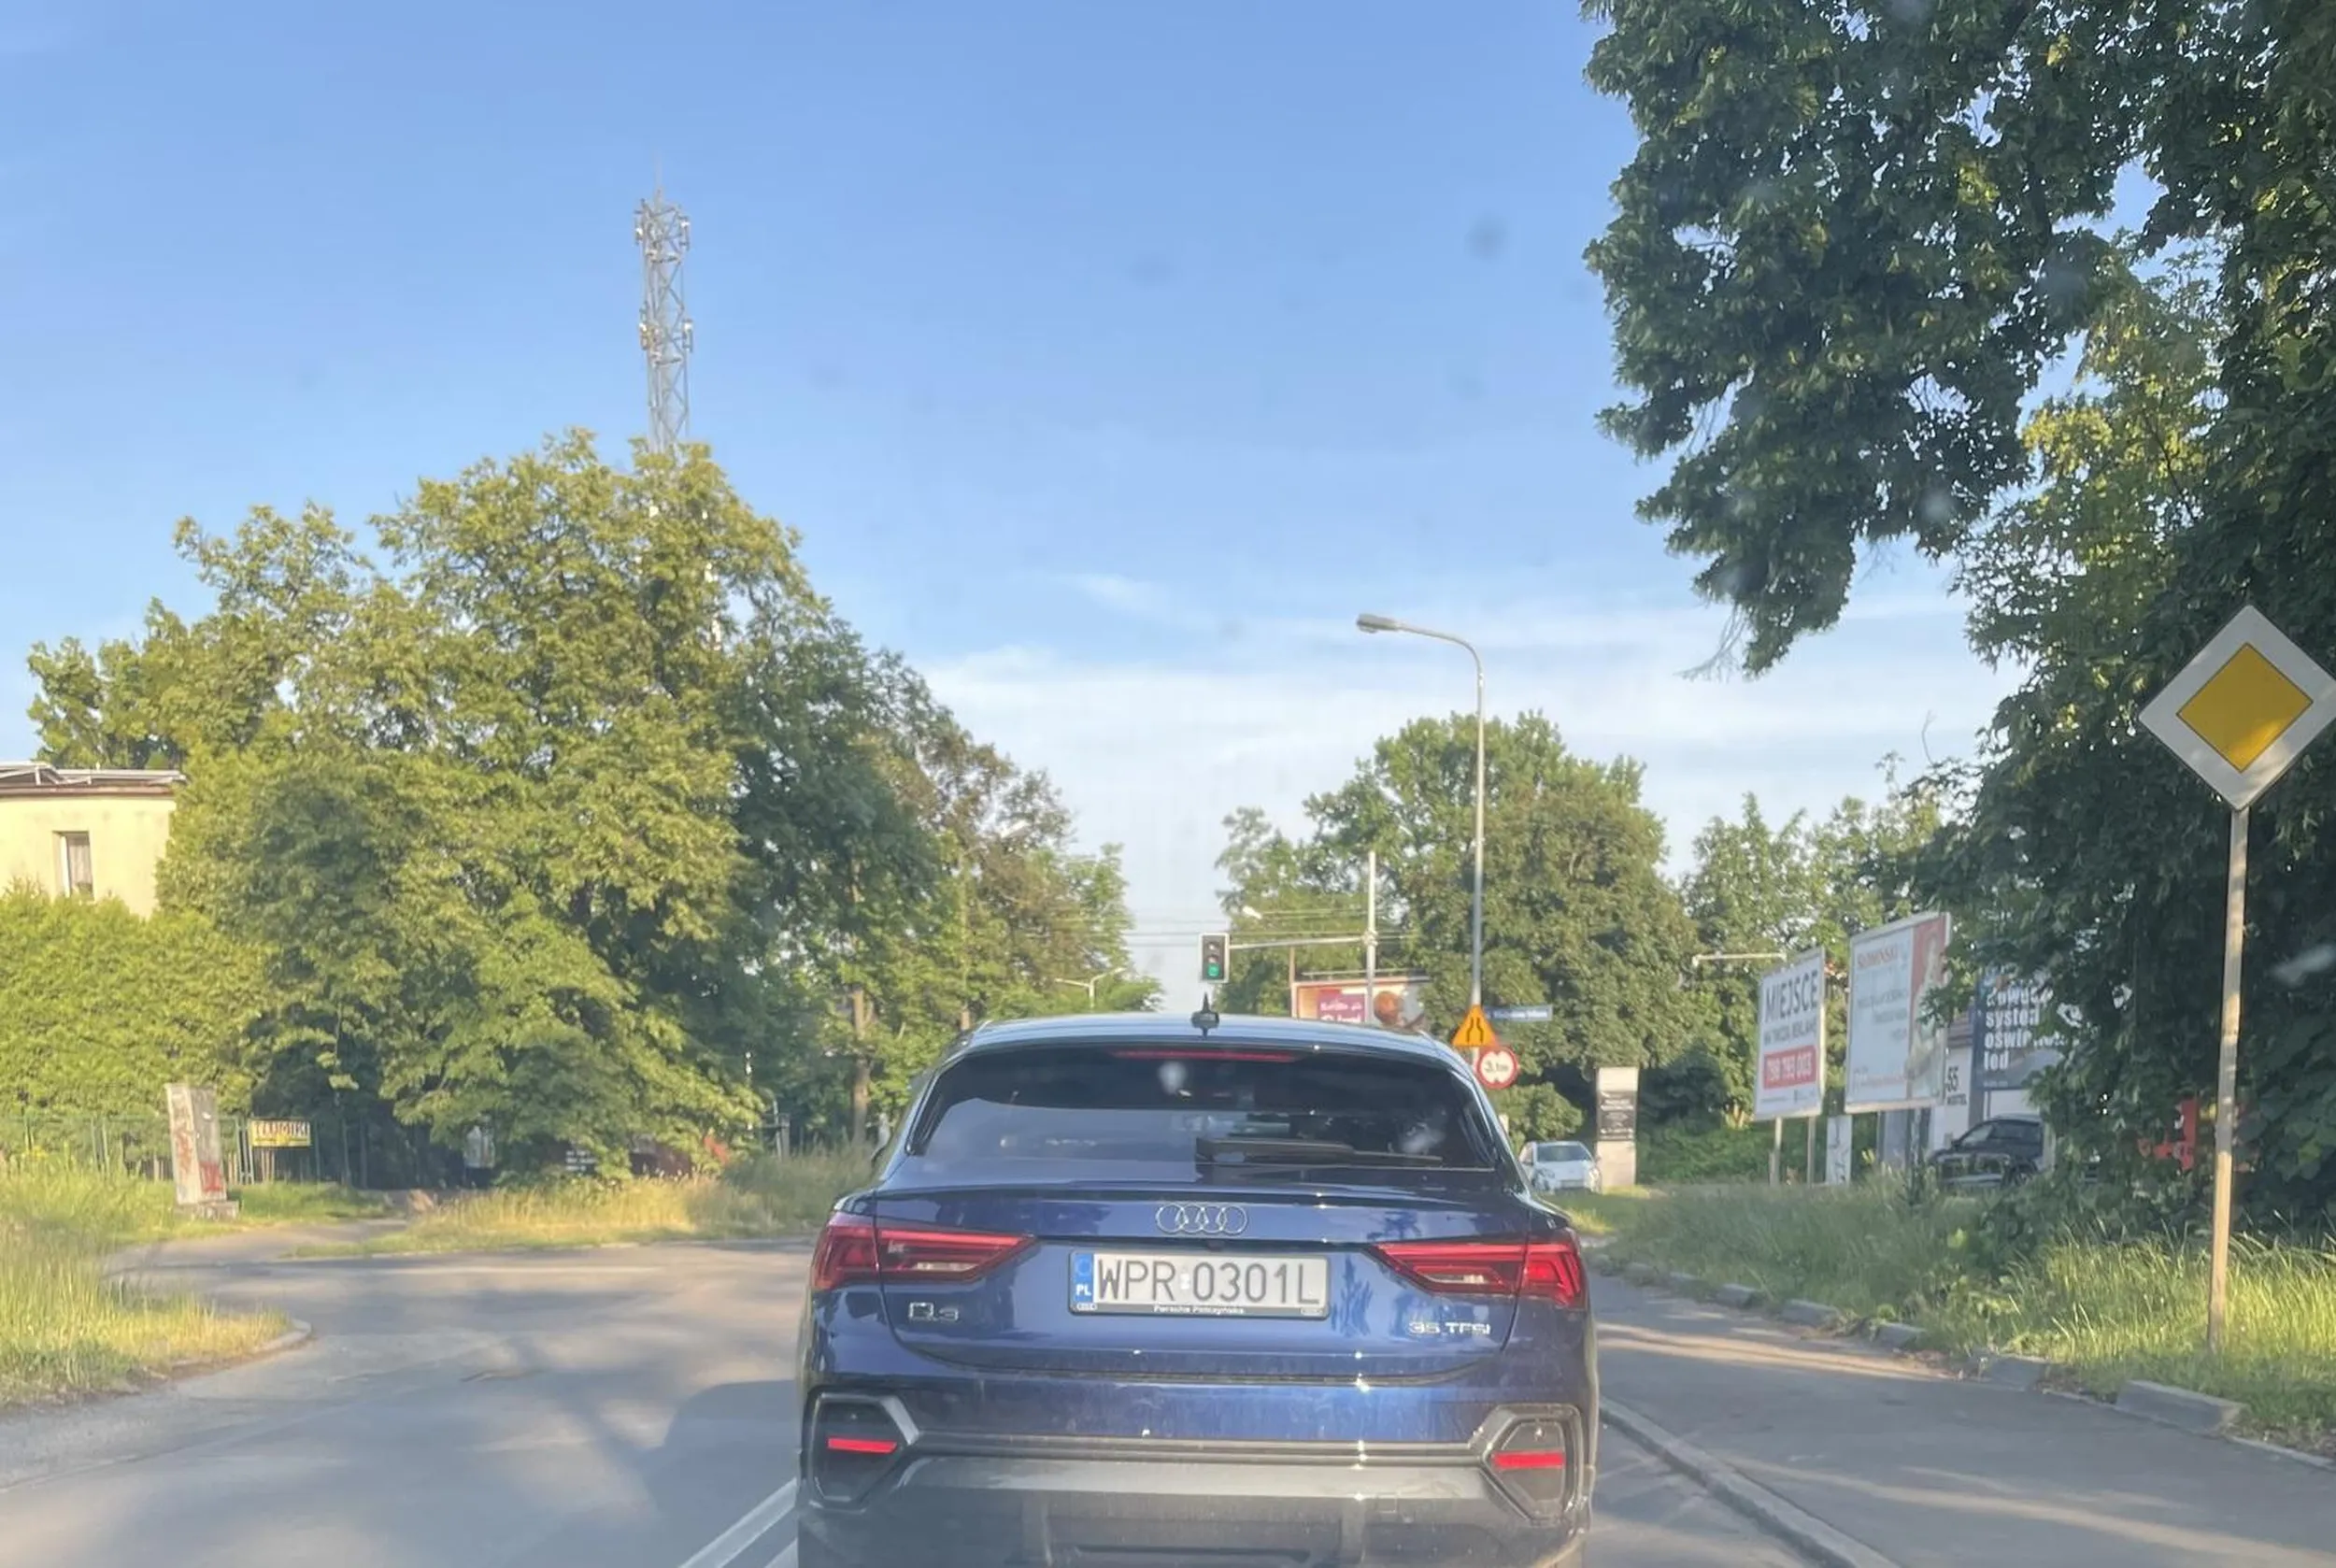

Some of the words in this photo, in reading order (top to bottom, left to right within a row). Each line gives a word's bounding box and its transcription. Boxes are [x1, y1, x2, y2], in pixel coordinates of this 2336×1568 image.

[1765, 969, 1817, 1023] MIEJSCE
[1076, 1284, 1092, 1296] PL
[1098, 1259, 1175, 1301] WPR
[1192, 1262, 1319, 1304] 0301L
[909, 1302, 960, 1321] Q3
[1409, 1321, 1440, 1334] 35
[1445, 1321, 1491, 1334] TFSI
